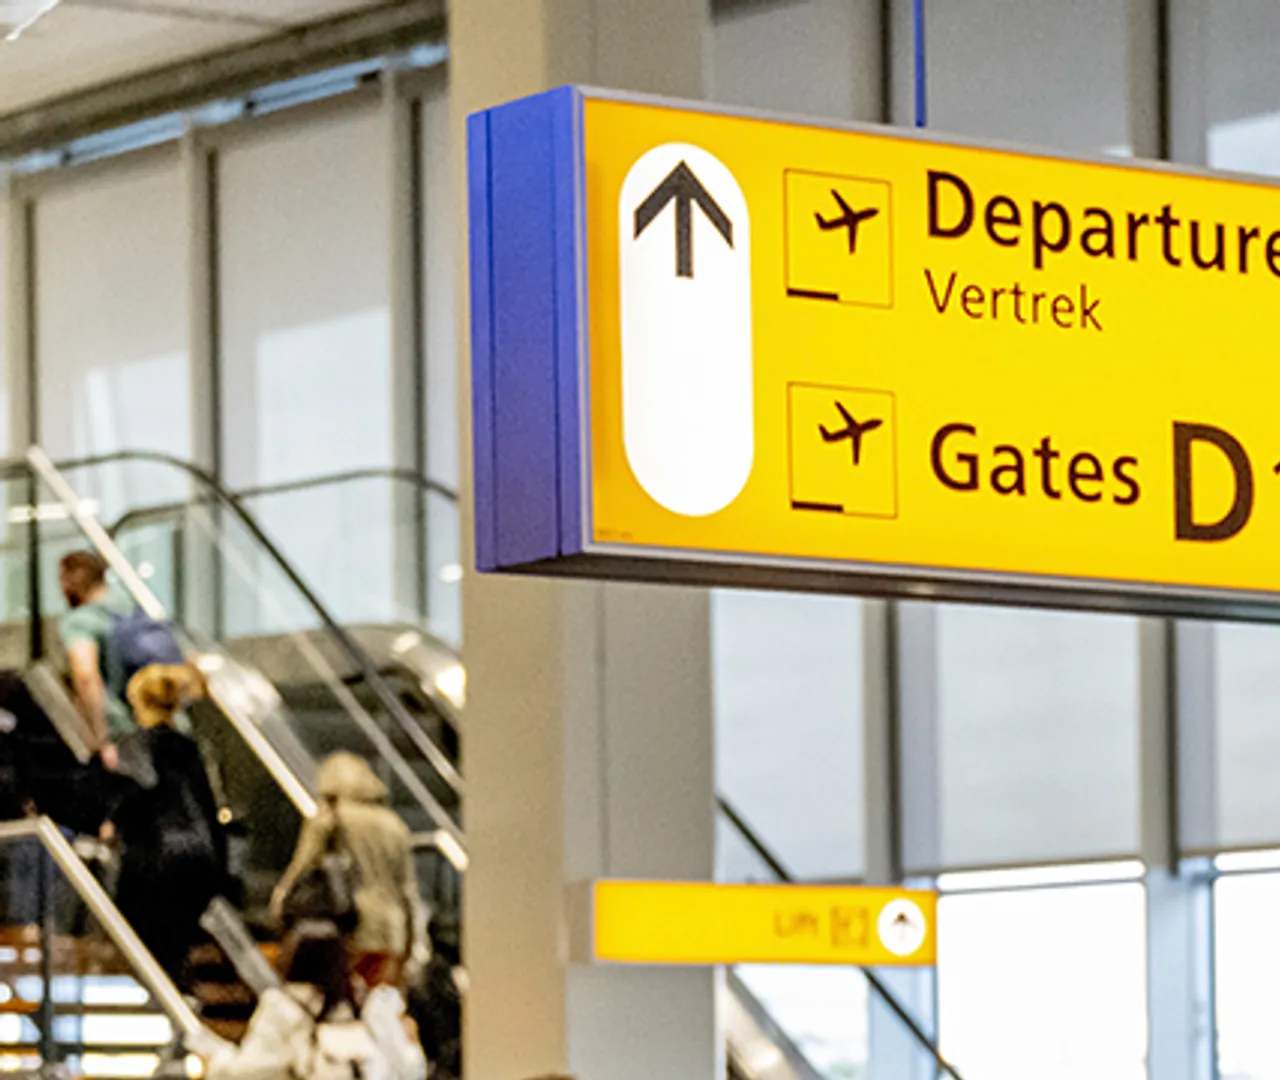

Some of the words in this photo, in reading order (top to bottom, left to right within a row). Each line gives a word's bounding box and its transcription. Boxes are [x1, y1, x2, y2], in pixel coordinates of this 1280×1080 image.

[923, 268, 1103, 331] Vertrek
[929, 422, 1142, 506] Gates
[1172, 420, 1256, 543] D
